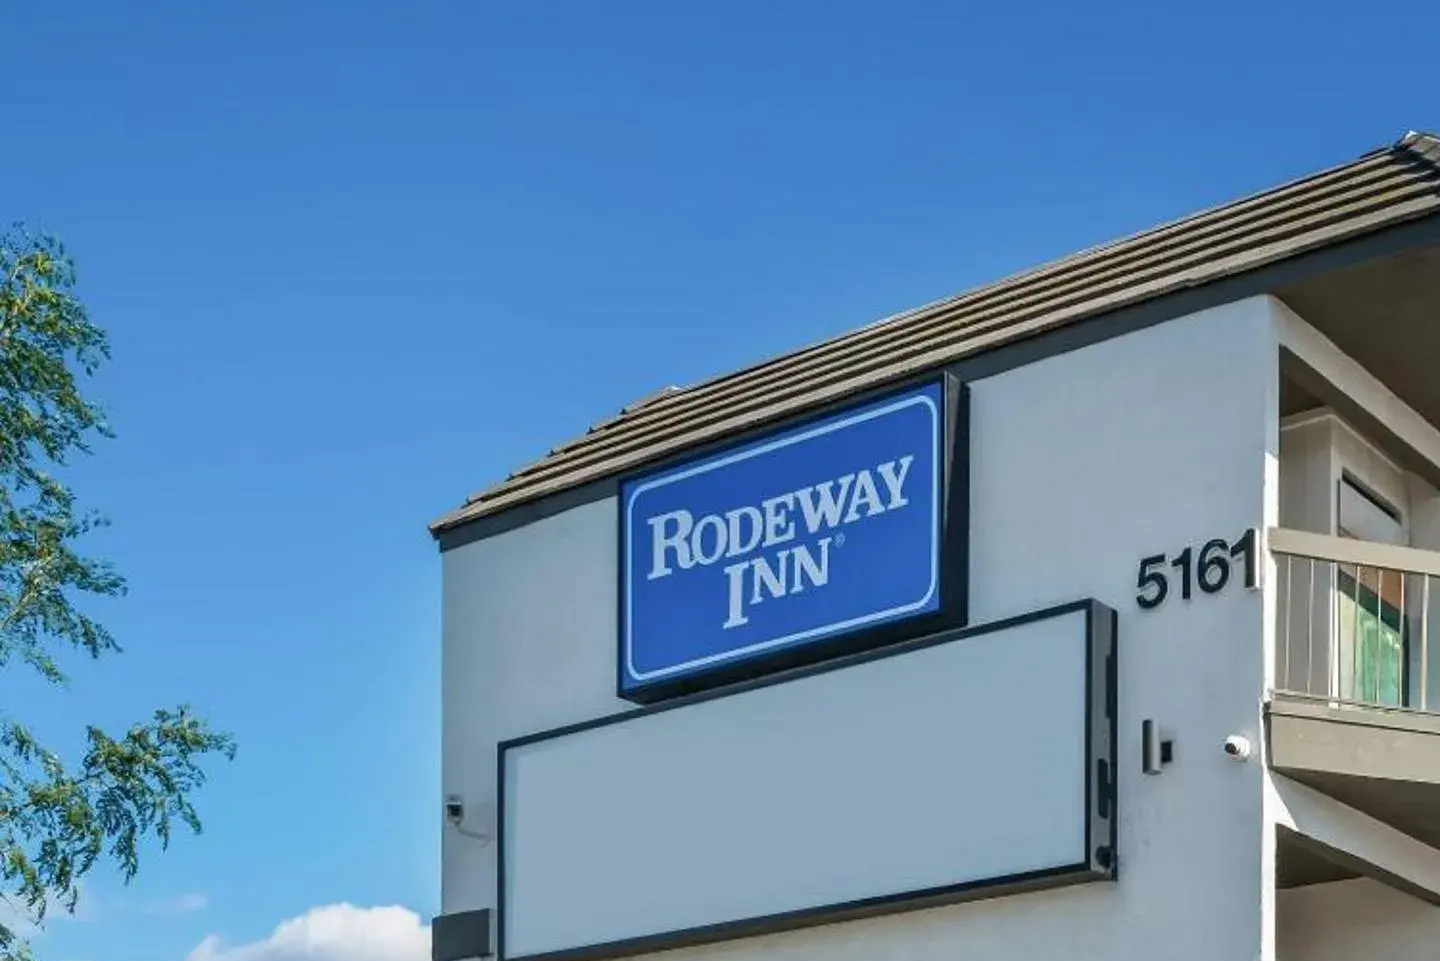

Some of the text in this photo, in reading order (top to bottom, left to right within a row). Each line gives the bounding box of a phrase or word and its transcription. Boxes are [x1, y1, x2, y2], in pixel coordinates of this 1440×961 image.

[647, 455, 914, 580] RODEWAY
[723, 536, 832, 629] INN
[1136, 527, 1260, 609] 5161
